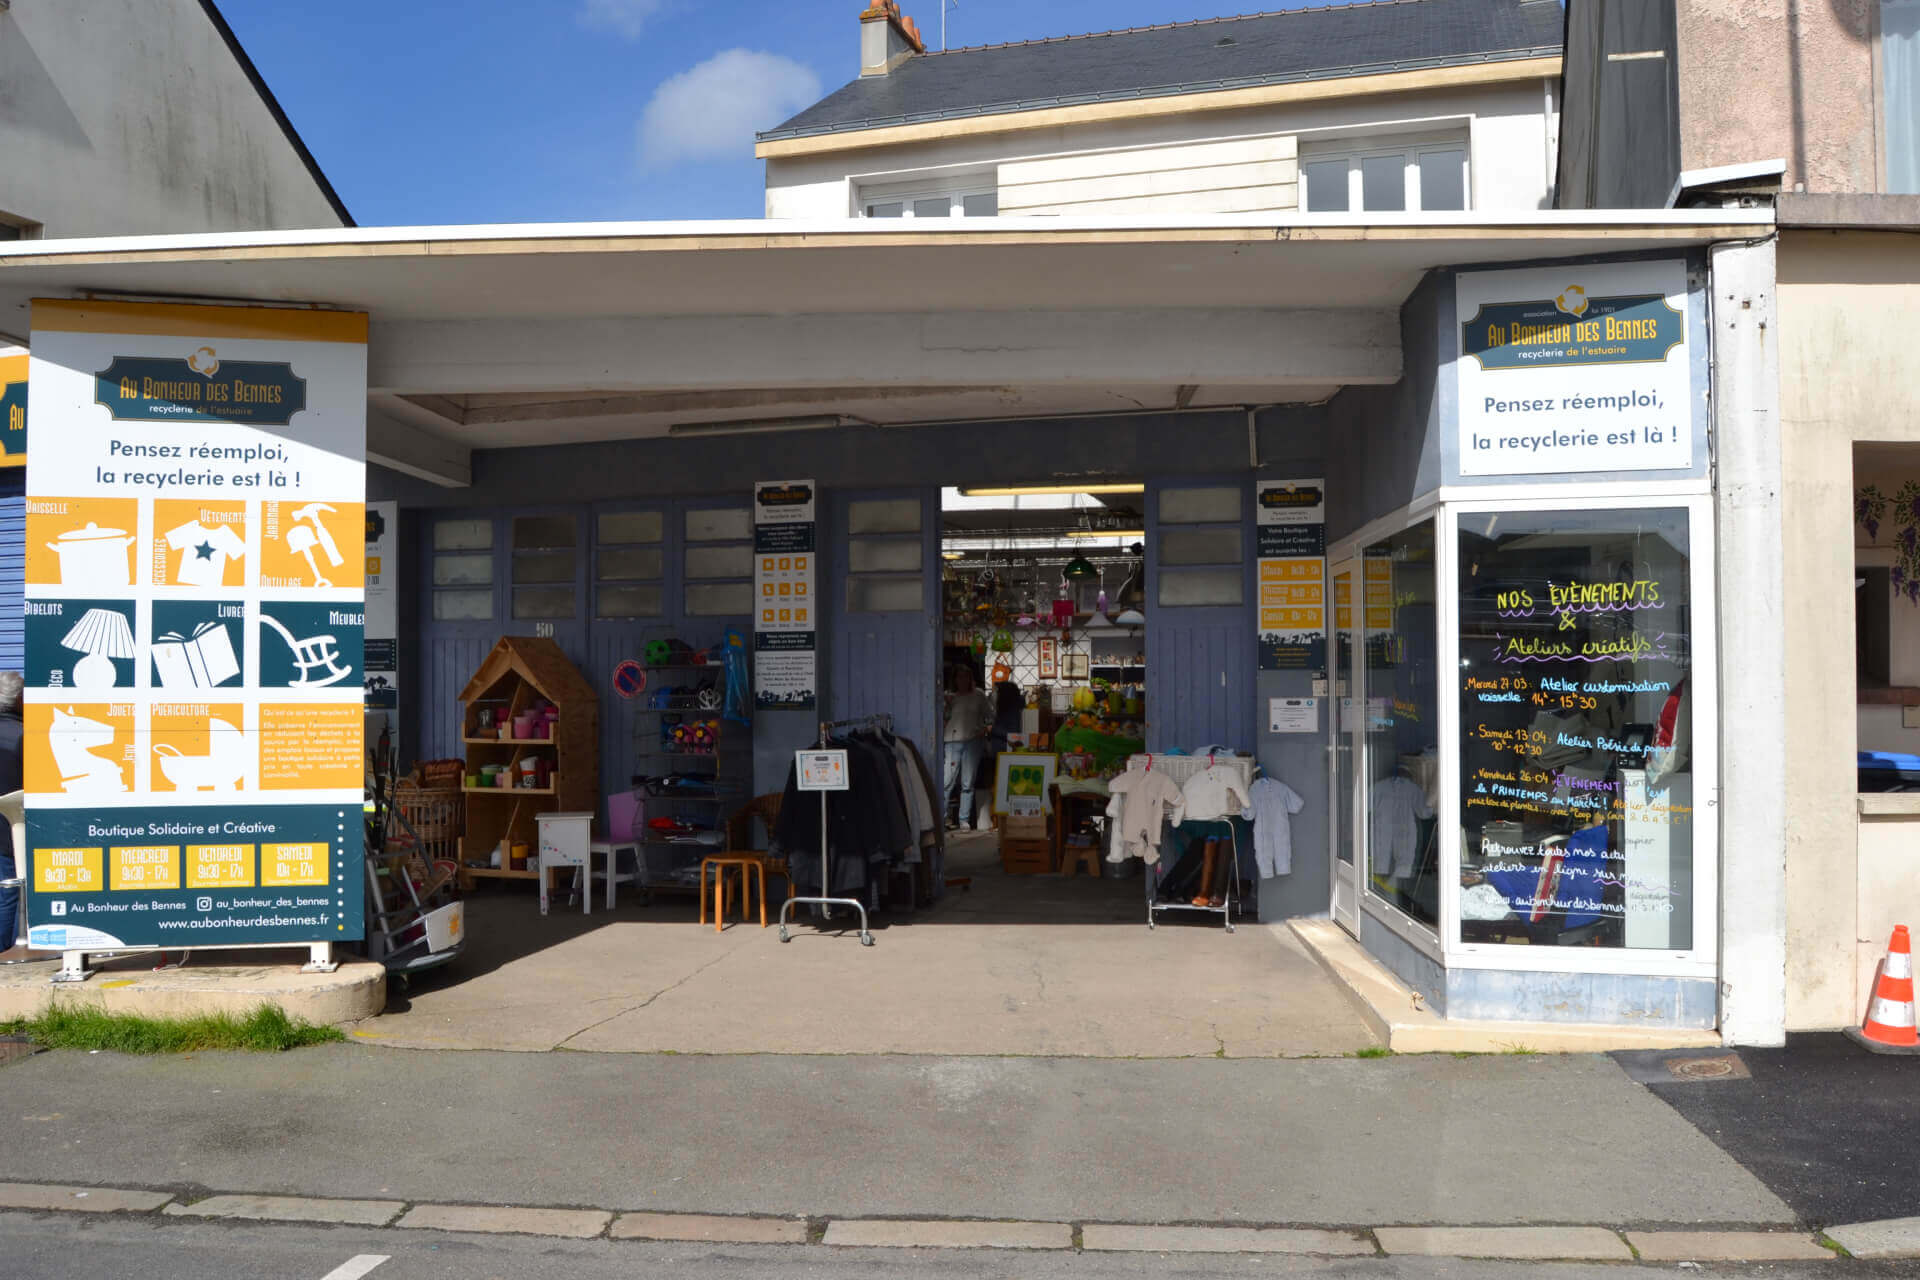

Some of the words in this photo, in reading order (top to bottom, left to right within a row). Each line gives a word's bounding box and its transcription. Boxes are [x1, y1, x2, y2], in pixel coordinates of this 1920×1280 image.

[1600, 305, 1616, 314] 1901
[1517, 347, 1564, 361] recyclerie
[1566, 348, 1579, 357] de
[1581, 345, 1627, 356] l'estuaire
[148, 404, 194, 417] recyclerie
[1484, 396, 1555, 414] Pensez
[1562, 388, 1664, 412] réemploi,
[1472, 432, 1492, 451] la
[1498, 427, 1600, 453] recyclerie
[1606, 428, 1636, 447] est
[1644, 425, 1664, 444] là
[1672, 425, 1678, 443] !
[109, 439, 183, 460] Pensez
[189, 441, 290, 466] réemploi,
[96, 465, 116, 485] la
[123, 467, 225, 489] recyclerie
[231, 471, 263, 488] est
[268, 469, 288, 489] là
[295, 470, 301, 488] !
[1496, 589, 1534, 609] NOS
[535, 622, 555, 638] 50
[1558, 610, 1577, 631] &
[1505, 637, 1573, 656] Ateliers
[1581, 630, 1652, 664] créatifs
[1540, 677, 1580, 692] Atelier
[1582, 679, 1671, 694] customisation
[1478, 723, 1514, 739] Samedi
[1556, 731, 1593, 749] Atelier
[1491, 783, 1549, 803] PRINTEMPS
[88, 824, 145, 839] Boutique
[148, 821, 205, 836] Solidaire
[207, 823, 220, 835] et
[223, 821, 276, 835] Créative
[1481, 836, 1536, 857] Retrouvez
[1537, 843, 1571, 858] toutes
[1572, 847, 1597, 858] nos
[1480, 861, 1527, 873] ateliers
[1530, 865, 1550, 873] en
[1553, 862, 1589, 881] ligne
[1592, 868, 1617, 881] sur
[70, 903, 85, 913] Au
[87, 902, 129, 912] Bonheur
[131, 901, 149, 911] des
[151, 900, 187, 911] Bennes
[216, 896, 329, 911] au_bonheur_des_bennes
[158, 913, 330, 930] www.aubonheurdesbennes.fr
